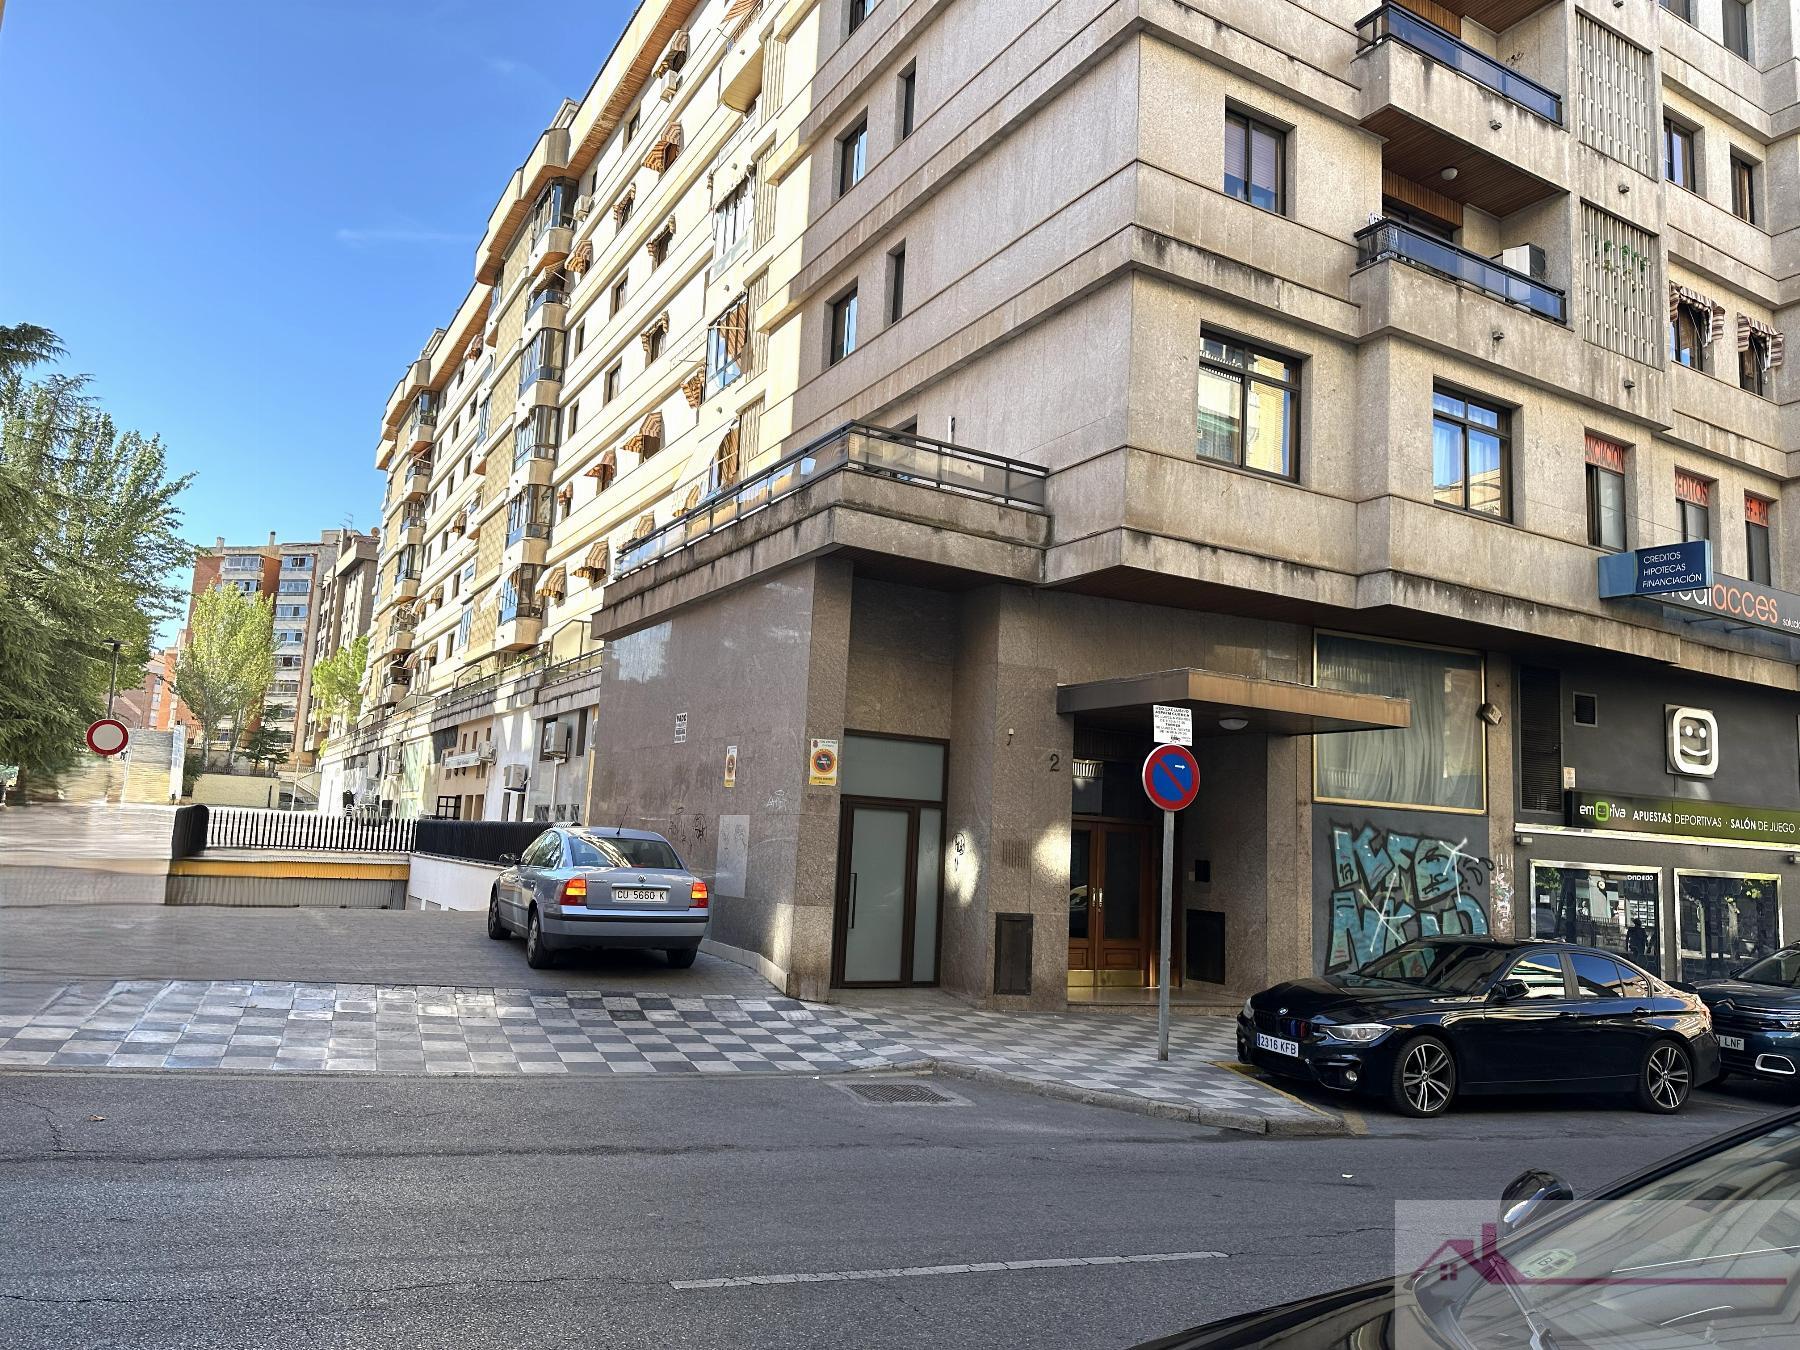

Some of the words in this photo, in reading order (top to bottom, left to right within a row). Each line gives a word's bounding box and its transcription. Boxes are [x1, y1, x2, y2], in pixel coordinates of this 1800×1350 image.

[1643, 552, 1681, 564] CREDITOS
[1643, 563, 1686, 576] HIPOTECAS
[1642, 573, 1702, 588] FINANCIACIÓN
[1049, 753, 1060, 773] 2
[1632, 810, 1672, 824] APUESTAS
[1674, 813, 1722, 828] DEPORTIVAS
[1730, 817, 1757, 830] SALÓN
[1758, 820, 1769, 831] DE
[1770, 822, 1796, 833] JUEGO
[659, 891, 665, 901] K
[1260, 1035, 1279, 1050] 2316
[1280, 1041, 1297, 1055] KFB
[1724, 1036, 1742, 1048] LNF
